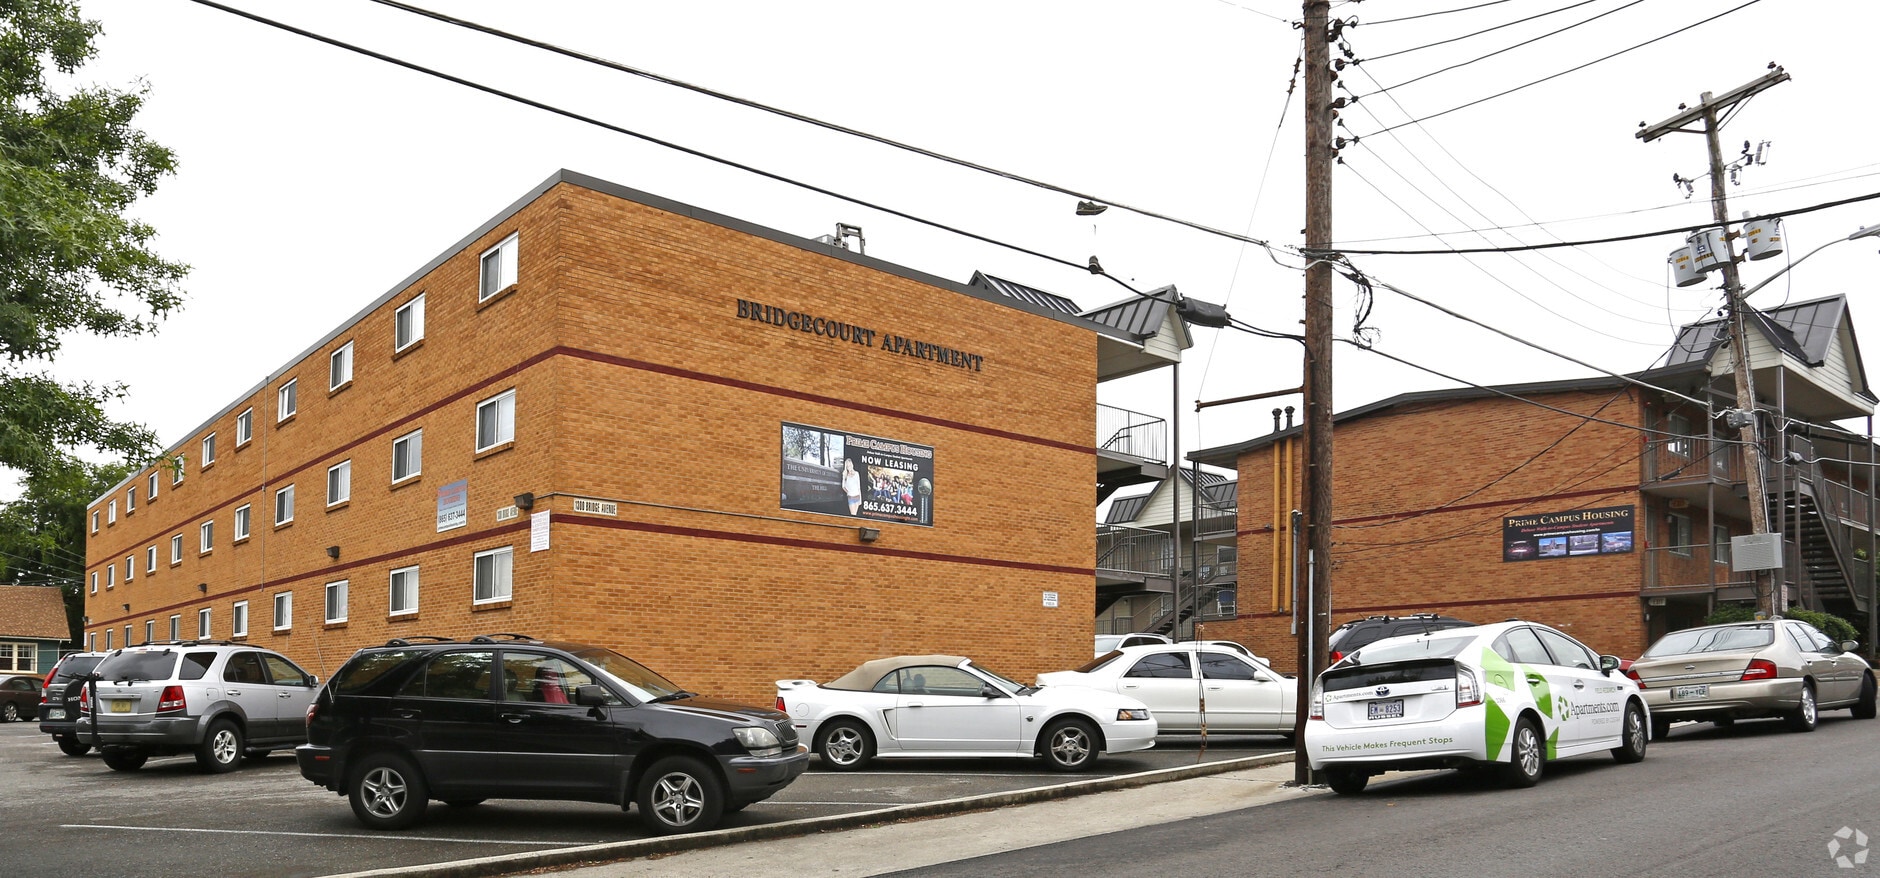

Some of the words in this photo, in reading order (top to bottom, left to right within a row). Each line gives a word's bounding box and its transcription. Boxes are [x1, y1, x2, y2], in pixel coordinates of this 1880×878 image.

[736, 298, 876, 347] BRIDGECOURT
[880, 333, 984, 372] APARTMENT
[861, 455, 881, 466] NOW
[885, 459, 919, 471] LEASING
[585, 501, 600, 513] BRIDGE
[601, 503, 616, 515] AVENUE
[863, 500, 918, 516] 865.637.3444
[1333, 690, 1374, 701] Apartments.com
[1385, 704, 1401, 714] 8253
[1570, 701, 1620, 719] Apartments.com
[1336, 743, 1362, 752] Vehicle
[1363, 742, 1388, 750] Makes
[1389, 739, 1426, 749] Frequent
[1428, 736, 1454, 747] Stops
